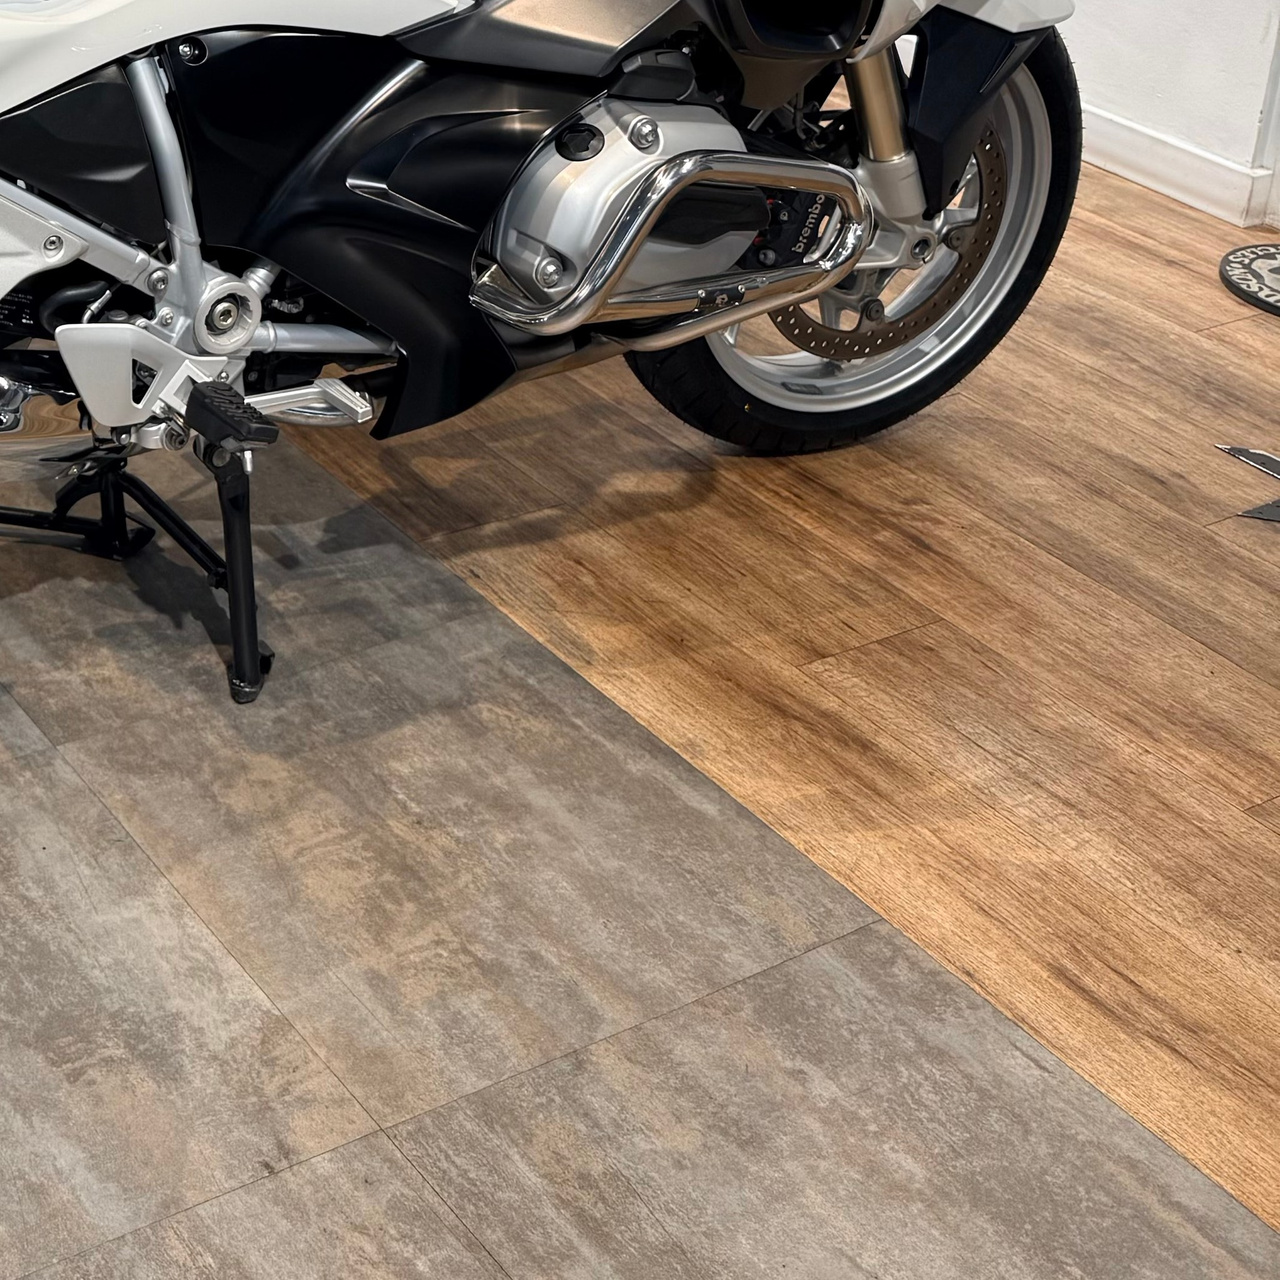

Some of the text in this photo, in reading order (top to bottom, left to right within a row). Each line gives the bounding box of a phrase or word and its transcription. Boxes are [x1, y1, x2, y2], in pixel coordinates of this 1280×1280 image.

[791, 194, 825, 253] brembo
[1227, 245, 1280, 264] CLES
[1225, 265, 1280, 307] DSON
